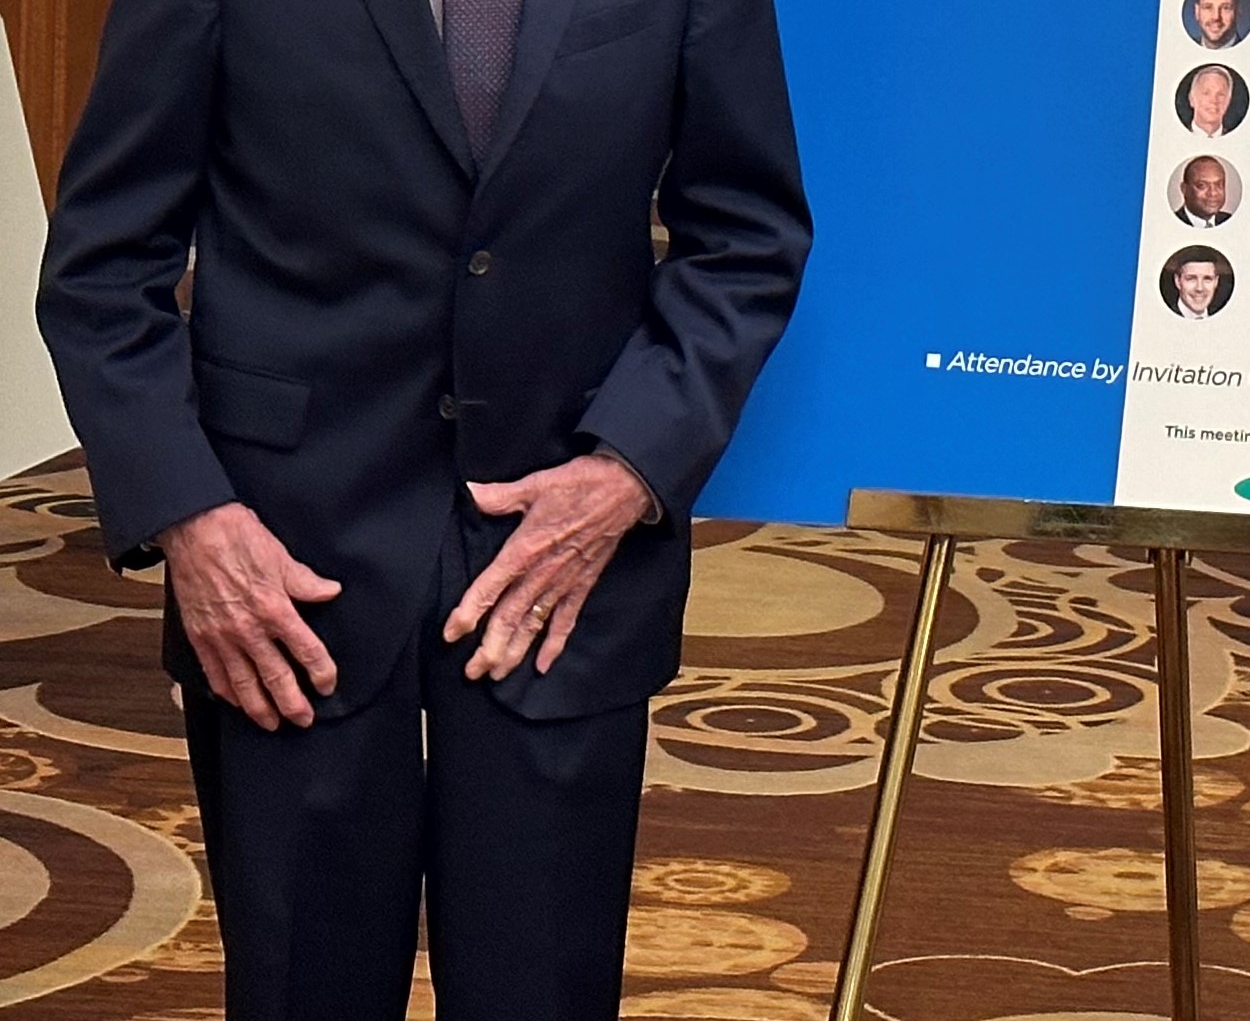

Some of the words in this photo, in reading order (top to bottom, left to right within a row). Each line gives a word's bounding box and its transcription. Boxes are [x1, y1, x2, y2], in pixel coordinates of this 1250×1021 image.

[947, 352, 1086, 378] Attendance
[1092, 358, 1123, 383] by
[1133, 362, 1241, 386] Invitation
[1164, 426, 1196, 438] This
